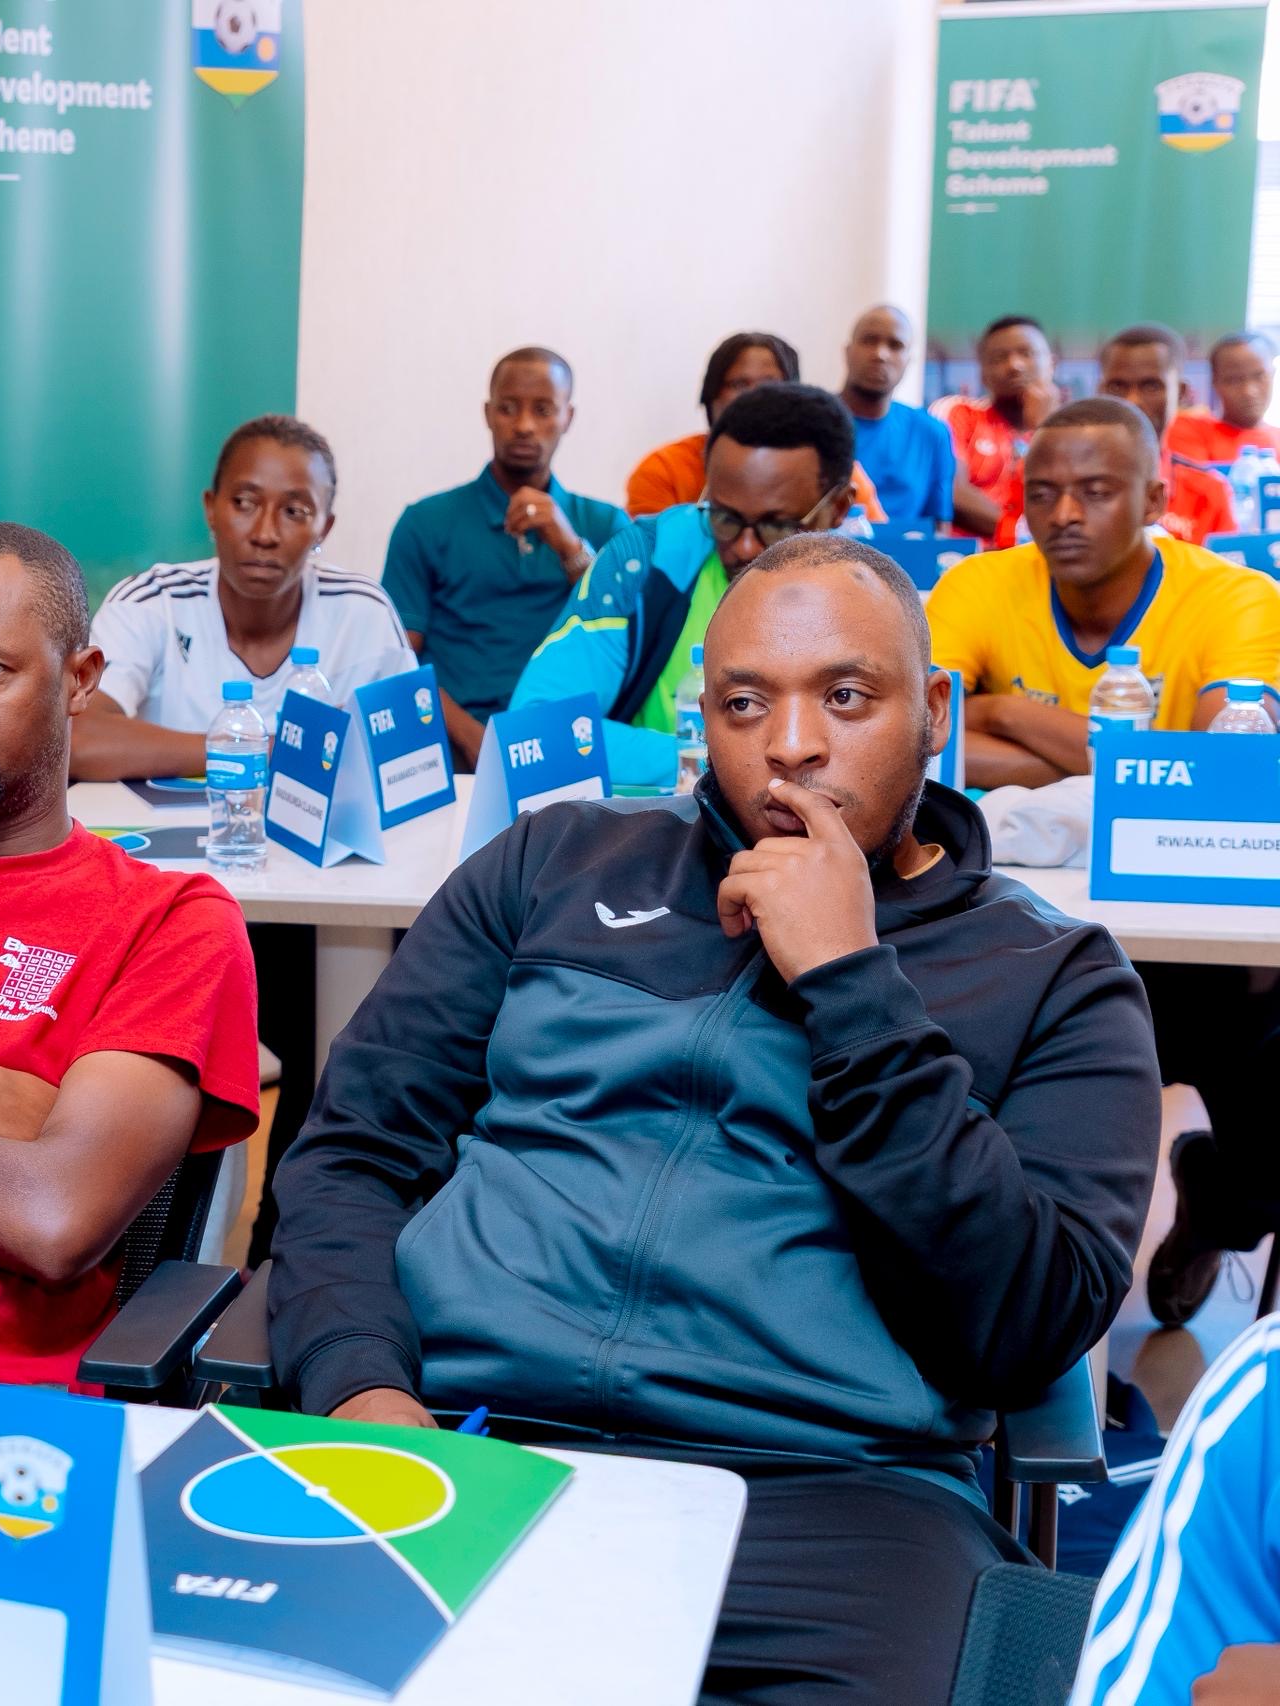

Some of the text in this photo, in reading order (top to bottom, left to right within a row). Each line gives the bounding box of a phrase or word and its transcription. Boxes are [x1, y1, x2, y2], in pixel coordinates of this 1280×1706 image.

[948, 78, 1037, 113] FIFA
[948, 119, 1031, 143] Talent
[947, 144, 1118, 172] Development
[945, 173, 1049, 197] Scheme
[280, 720, 303, 750] FIFA
[368, 708, 396, 736] FIFA
[508, 738, 544, 769] FIFA
[1114, 758, 1193, 786] FIFA
[1156, 835, 1215, 849] RWAKA
[176, 1574, 279, 1604] FIFA
